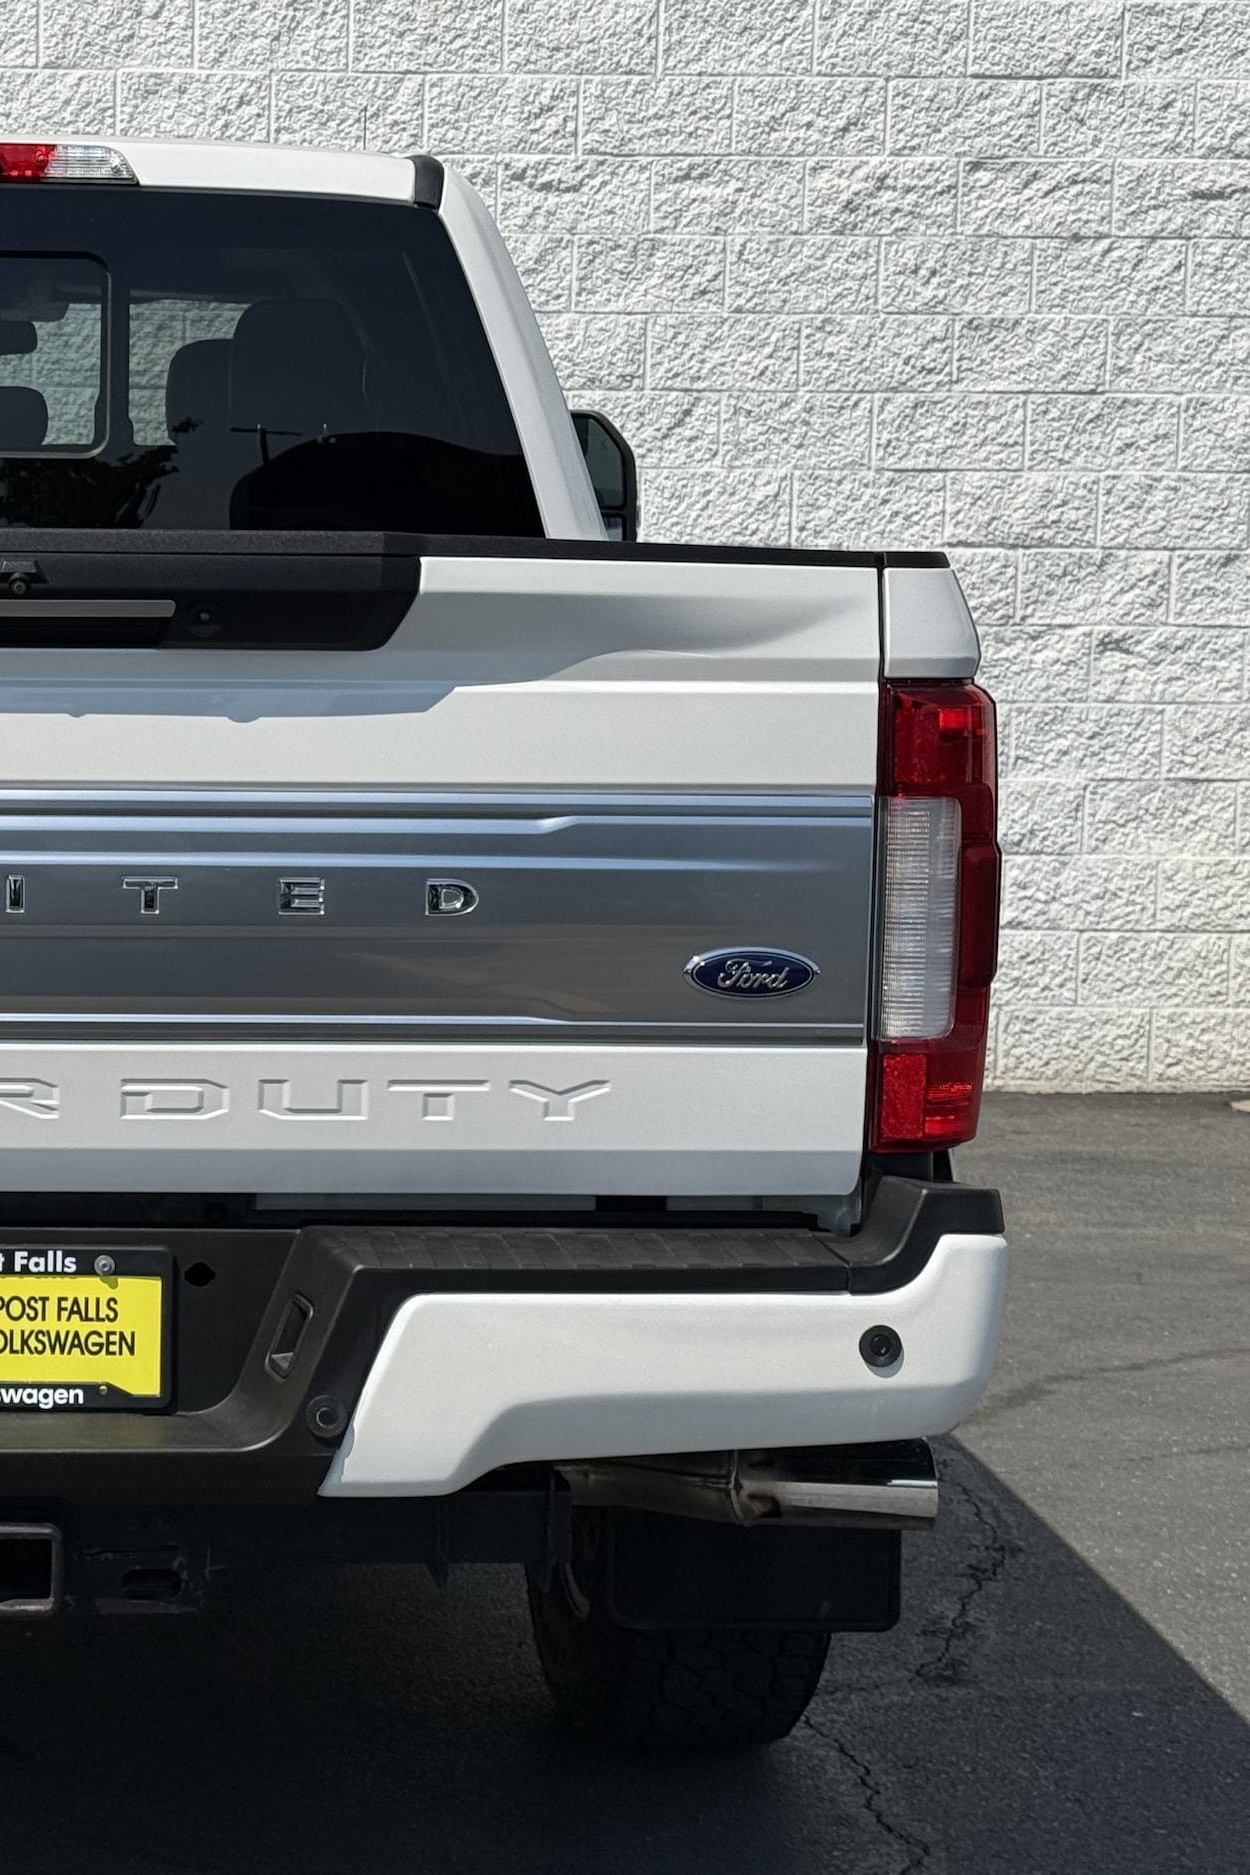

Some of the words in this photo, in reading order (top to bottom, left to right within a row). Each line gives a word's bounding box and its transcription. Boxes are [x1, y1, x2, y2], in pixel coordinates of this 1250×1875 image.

[717, 958, 790, 989] Ford
[120, 1078, 611, 1122] DUTY
[14, 1251, 77, 1273] Falls
[57, 1296, 119, 1323] FALLS
